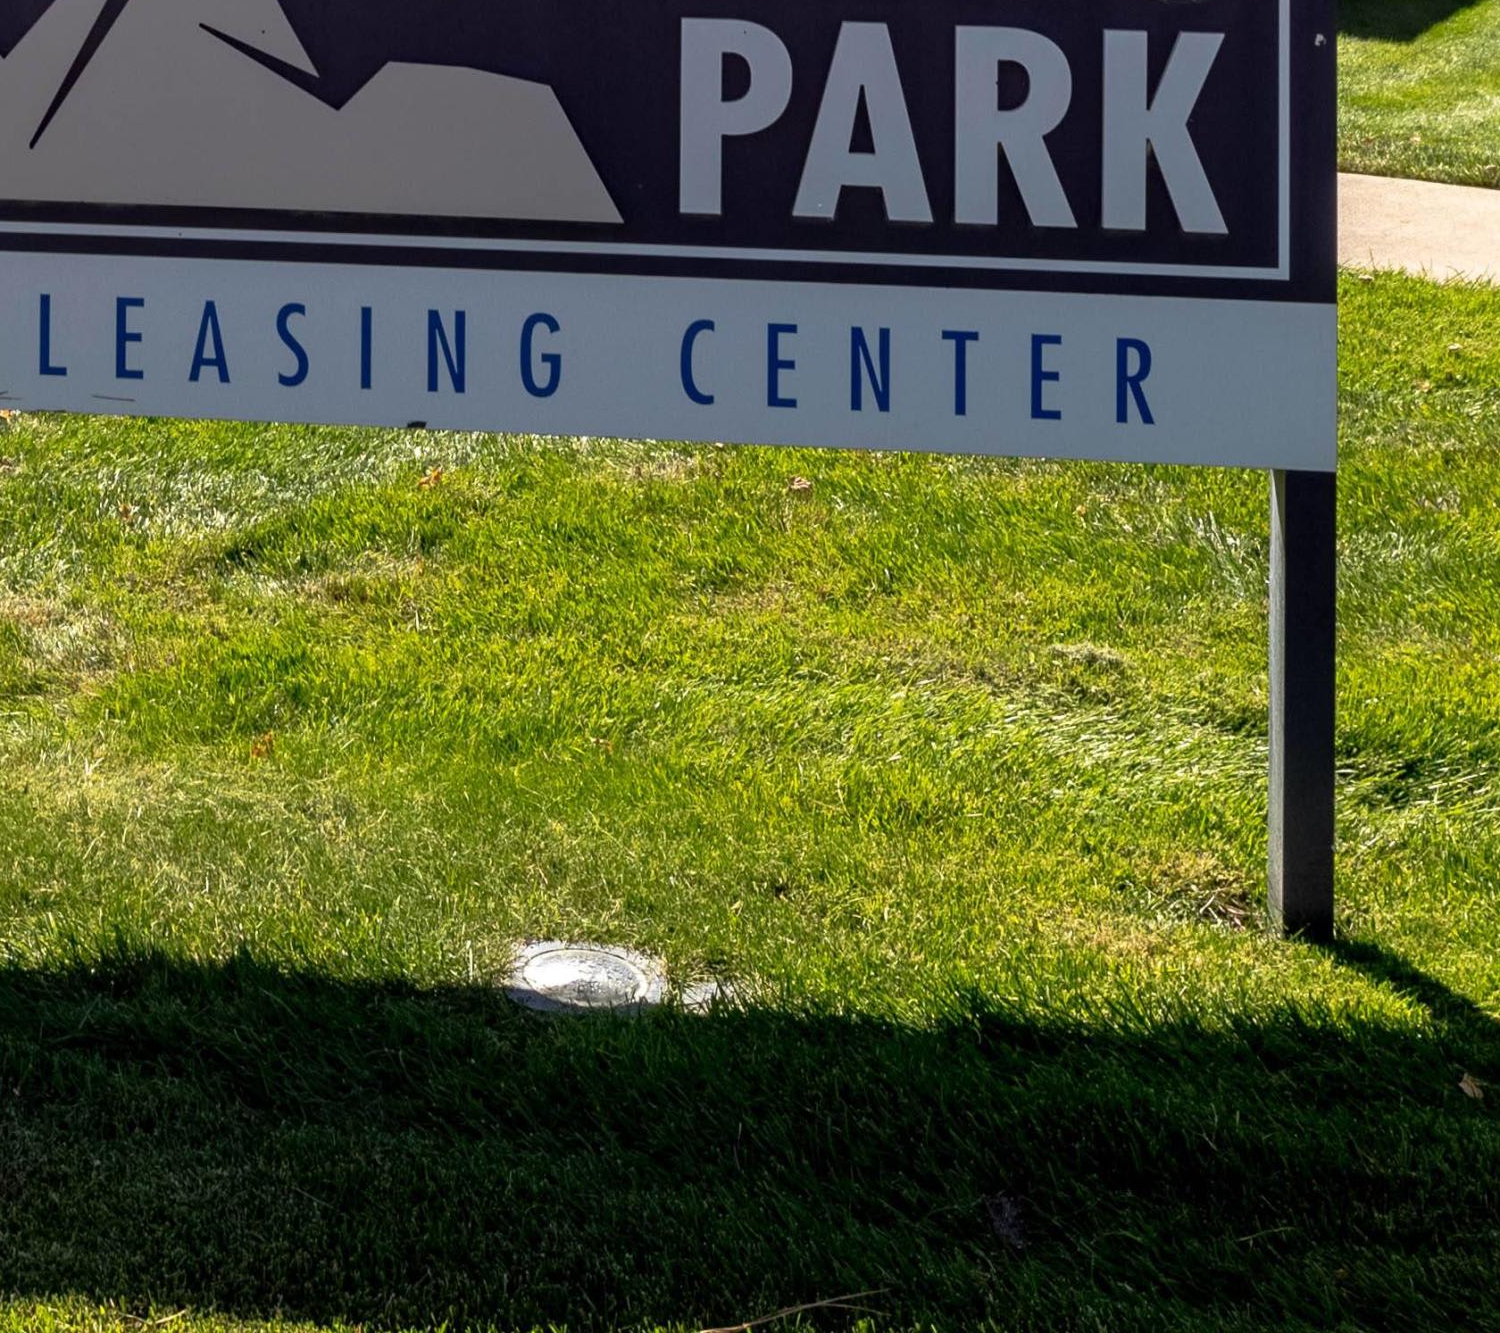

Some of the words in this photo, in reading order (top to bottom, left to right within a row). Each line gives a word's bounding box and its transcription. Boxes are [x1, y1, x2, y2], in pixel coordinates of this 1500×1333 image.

[680, 17, 1229, 235] PARK
[38, 292, 563, 400] LEASING
[680, 318, 1157, 426] CENTER
